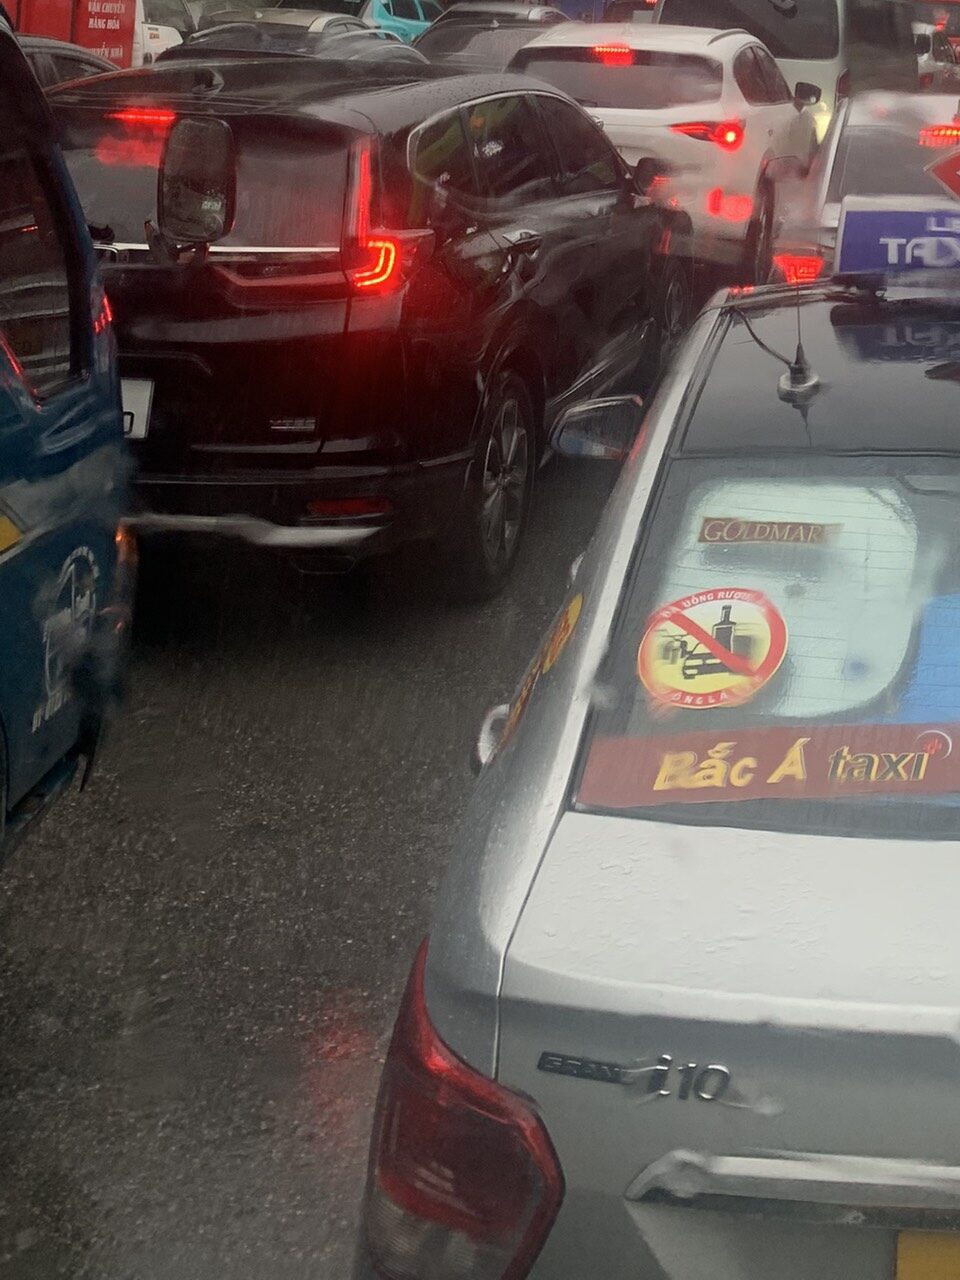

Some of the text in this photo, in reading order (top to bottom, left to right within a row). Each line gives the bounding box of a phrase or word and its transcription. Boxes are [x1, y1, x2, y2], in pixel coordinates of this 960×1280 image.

[704, 520, 826, 542] GOLDMAR
[653, 741, 758, 790] Bắc
[766, 736, 812, 783] Á
[828, 742, 935, 782] taxi
